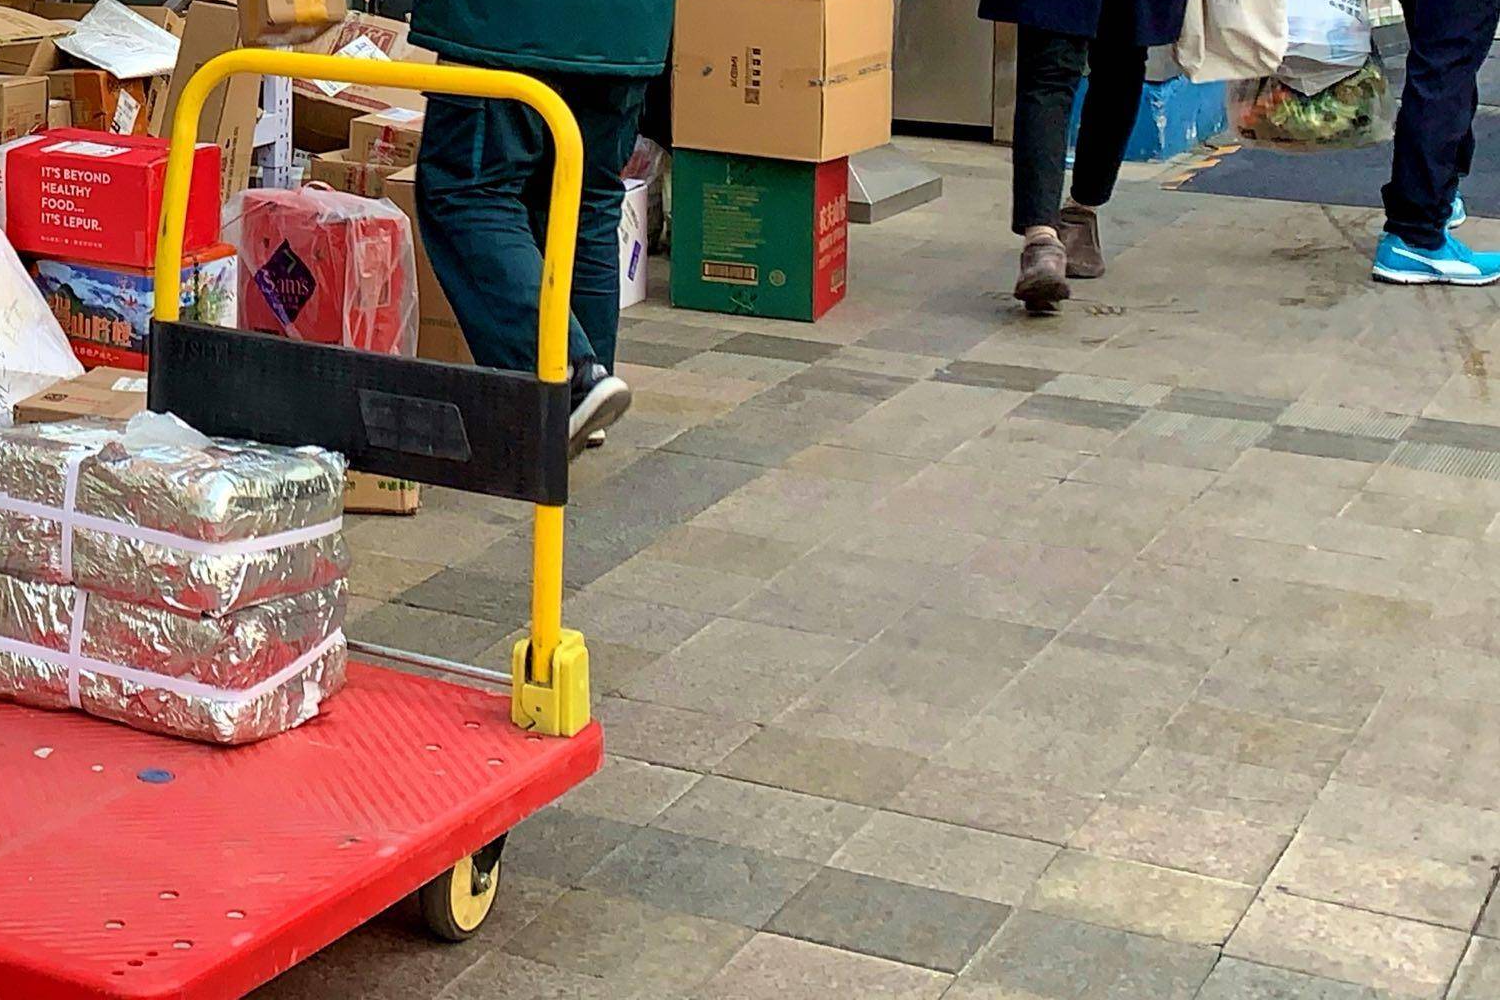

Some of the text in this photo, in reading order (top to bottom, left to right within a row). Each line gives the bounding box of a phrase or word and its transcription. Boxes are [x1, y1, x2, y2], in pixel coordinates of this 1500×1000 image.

[41, 166, 111, 185] IT'S BEYOND
[41, 182, 92, 198] HEALTHY
[41, 197, 85, 213] FOOD...
[41, 213, 103, 232] IT'S LEPUR.
